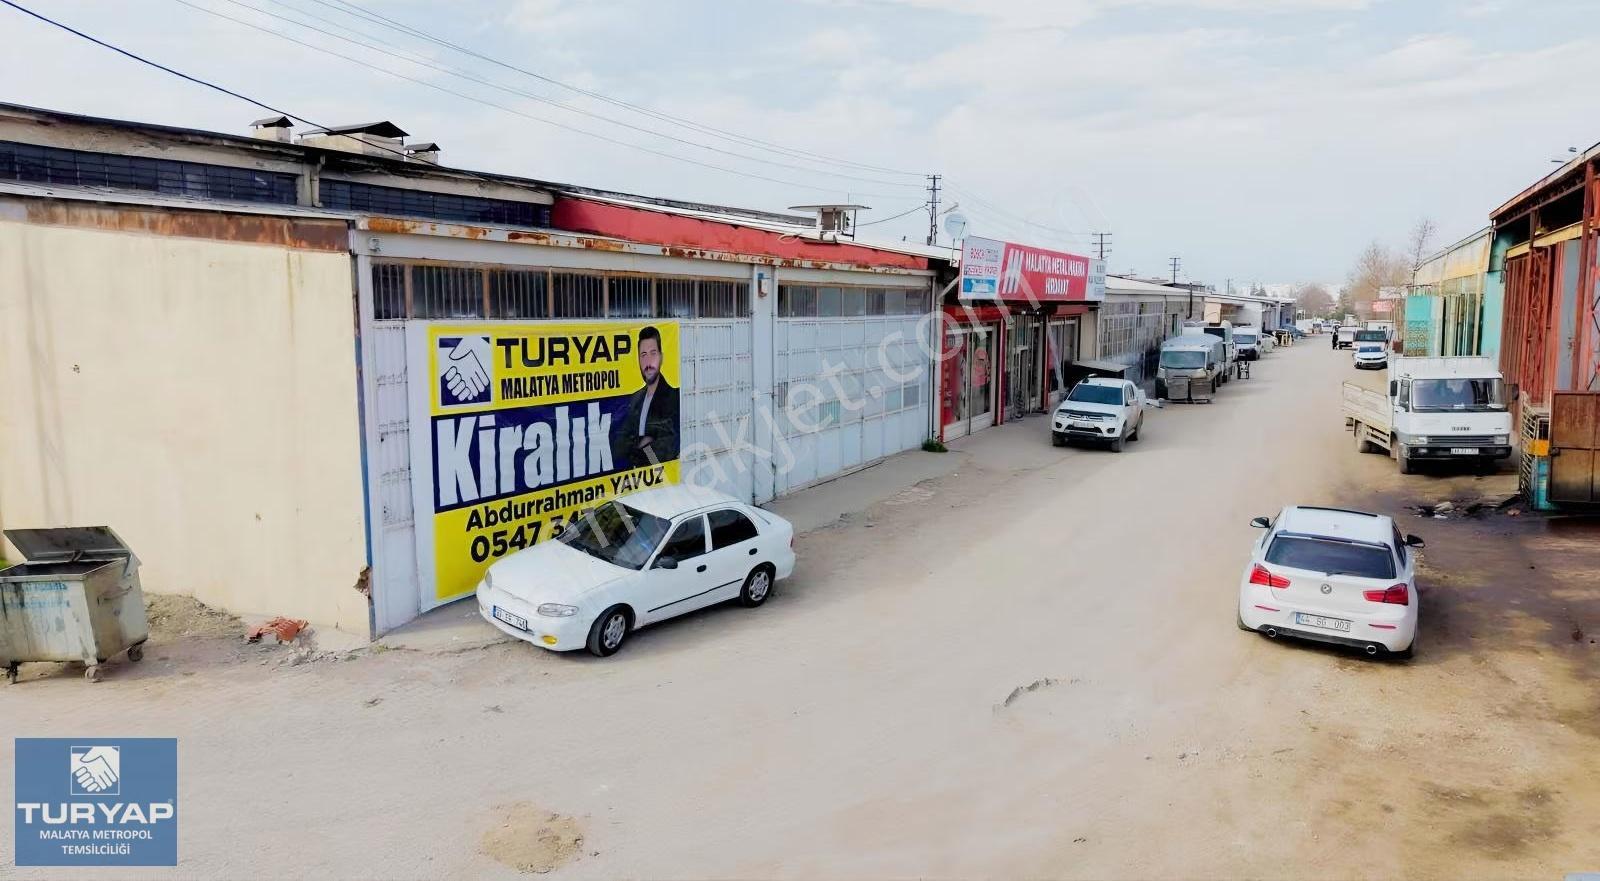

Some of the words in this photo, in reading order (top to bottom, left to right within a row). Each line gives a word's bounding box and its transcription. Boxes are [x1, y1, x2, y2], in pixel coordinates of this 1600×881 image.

[1025, 252, 1050, 273] MALATYA
[496, 335, 631, 369] TURYAP
[501, 376, 559, 400] MALATYA
[562, 370, 620, 393] METROPOL
[436, 402, 615, 507] Kiralık
[465, 483, 605, 532] Abdurrahman
[610, 466, 664, 494] YAVUZ
[470, 521, 542, 563] 0547
